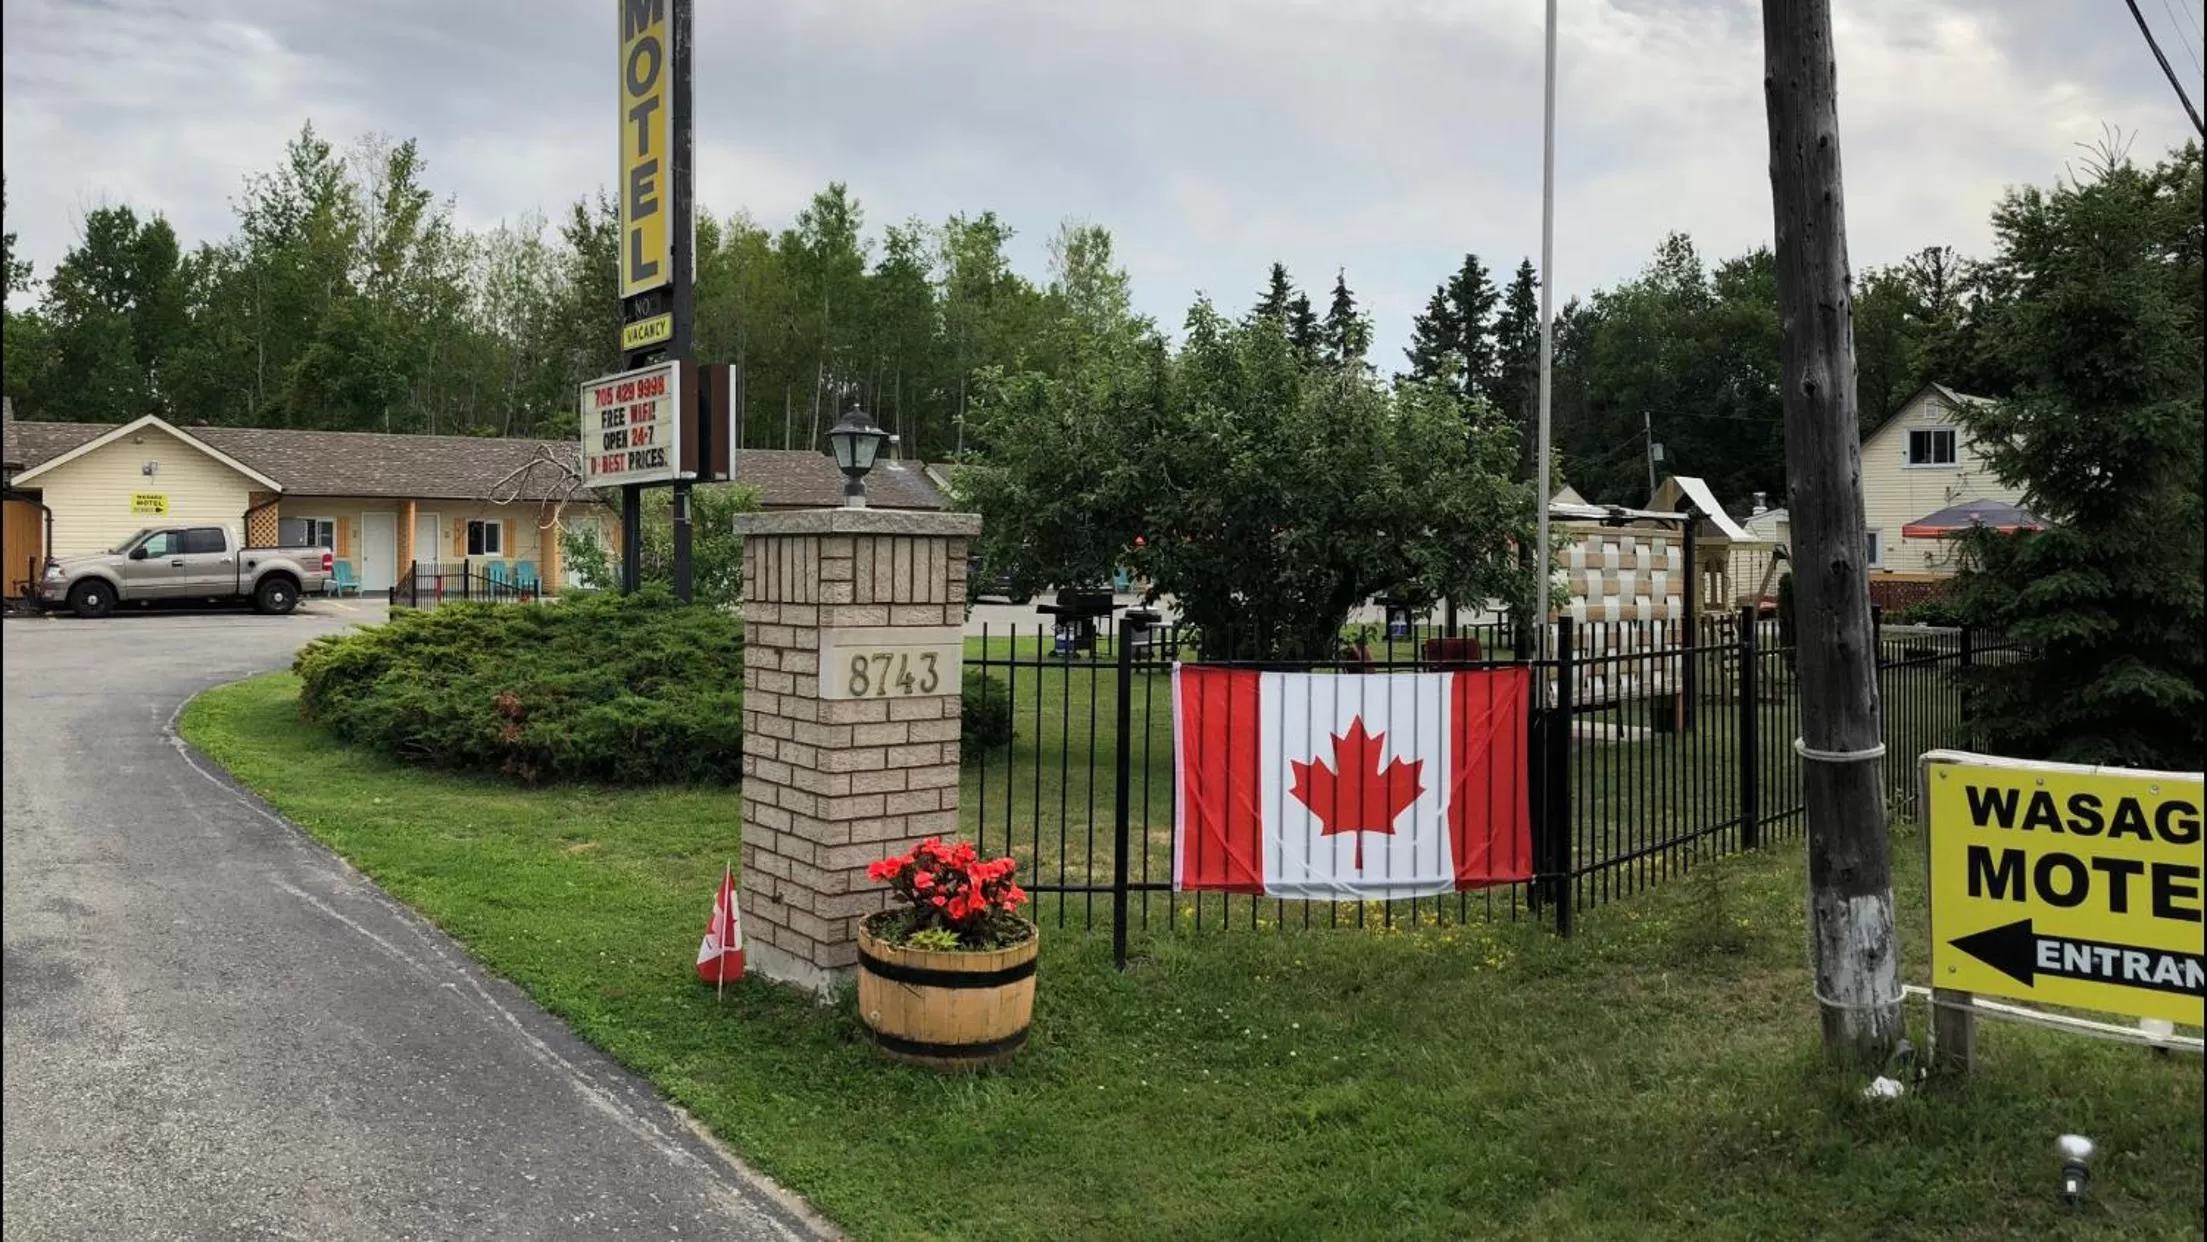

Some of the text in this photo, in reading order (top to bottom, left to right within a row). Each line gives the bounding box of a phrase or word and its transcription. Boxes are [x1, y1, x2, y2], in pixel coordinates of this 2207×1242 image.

[624, 0, 664, 283] MOTEL
[635, 298, 650, 317] NO
[626, 319, 666, 343] VACANCY
[594, 376, 665, 406] 705 429 9998
[601, 401, 656, 429] FREE WIFI!
[603, 425, 654, 450] OPEN 24-7
[849, 651, 939, 697] 8743
[1965, 785, 2202, 845] WASAG
[1967, 845, 2203, 923] MOTE
[2036, 939, 2205, 989] ENTRAN
